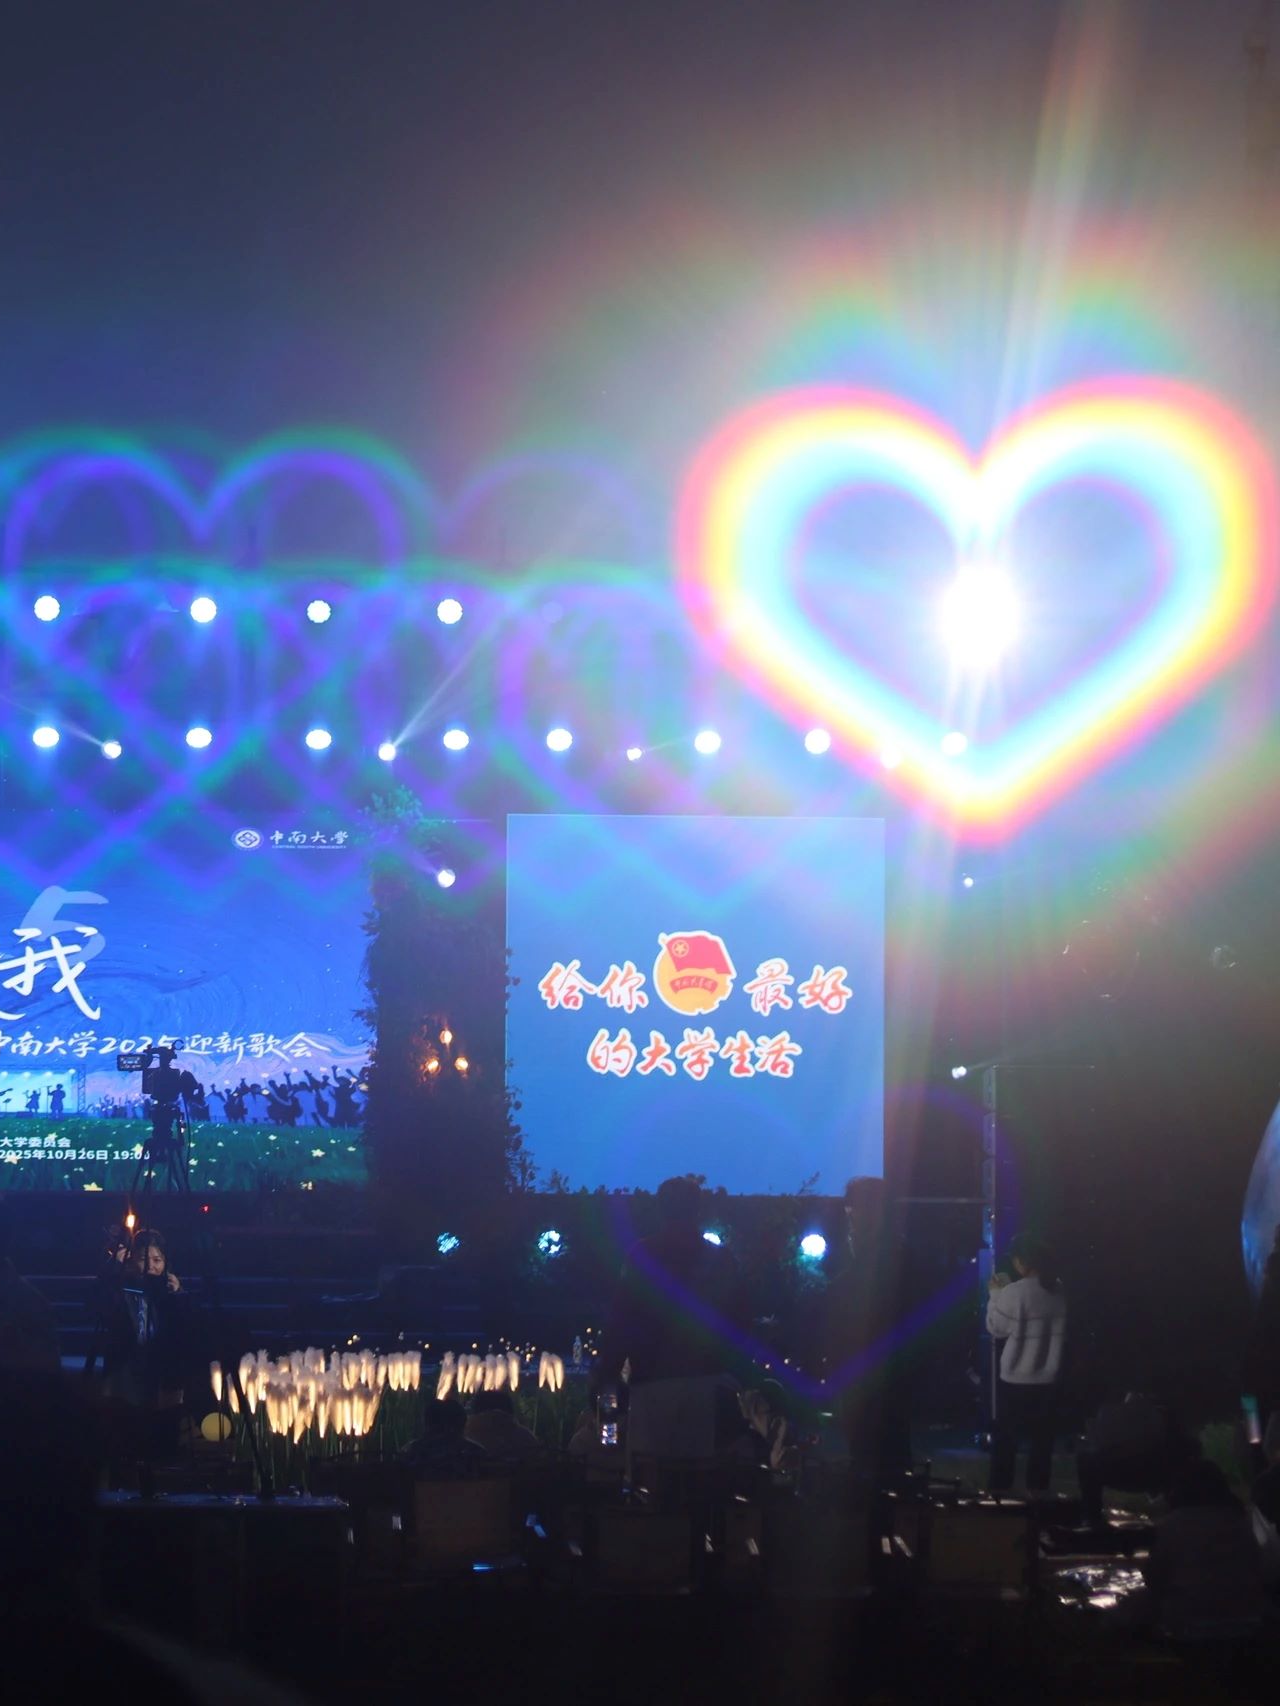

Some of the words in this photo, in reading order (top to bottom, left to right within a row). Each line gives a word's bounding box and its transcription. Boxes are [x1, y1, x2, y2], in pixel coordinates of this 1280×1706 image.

[269, 830, 348, 845] 中南大学
[538, 959, 649, 1014] 给你
[743, 957, 853, 1017] 最好
[586, 1026, 802, 1081] 的大学生活
